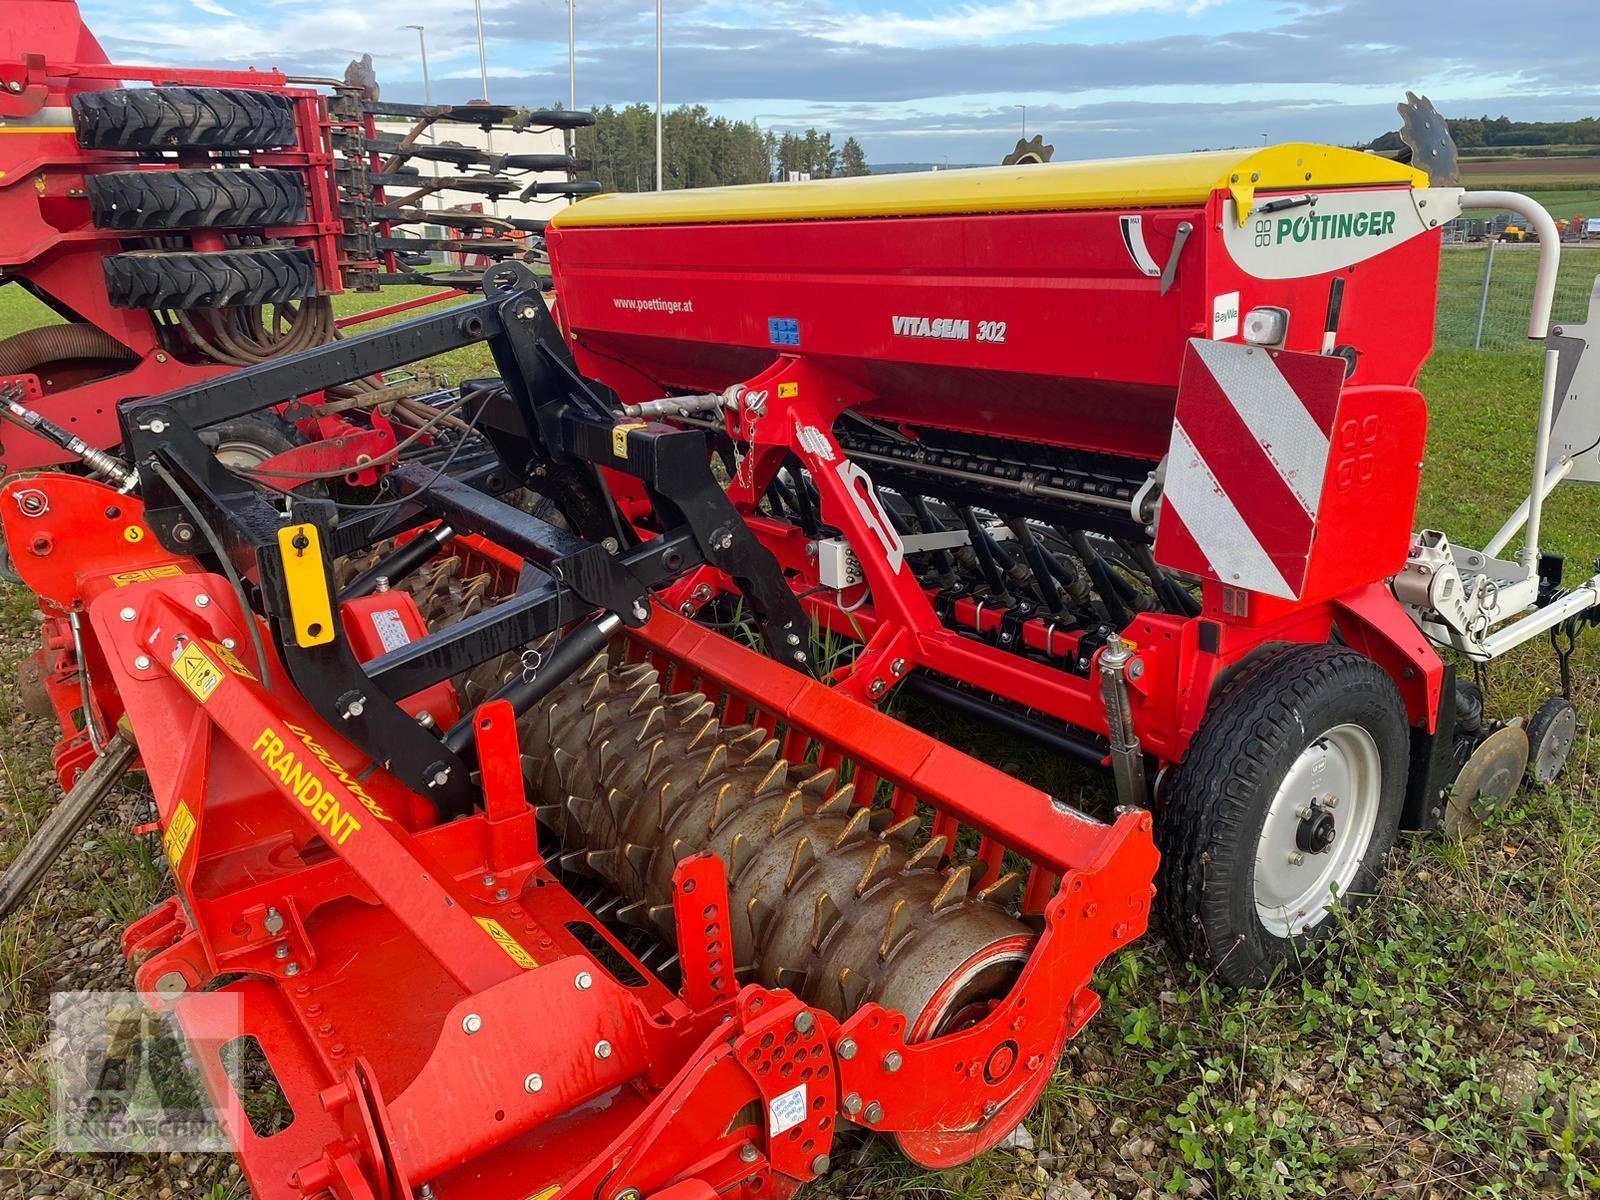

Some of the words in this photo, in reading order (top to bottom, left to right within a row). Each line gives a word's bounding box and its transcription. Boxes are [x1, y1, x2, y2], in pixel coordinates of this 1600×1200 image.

[612, 298, 694, 314] www.poettinger.at
[1215, 307, 1238, 323] BayWa
[891, 315, 970, 340] VITASEM
[975, 320, 1007, 342] 302
[252, 727, 362, 845] FRANDENT
